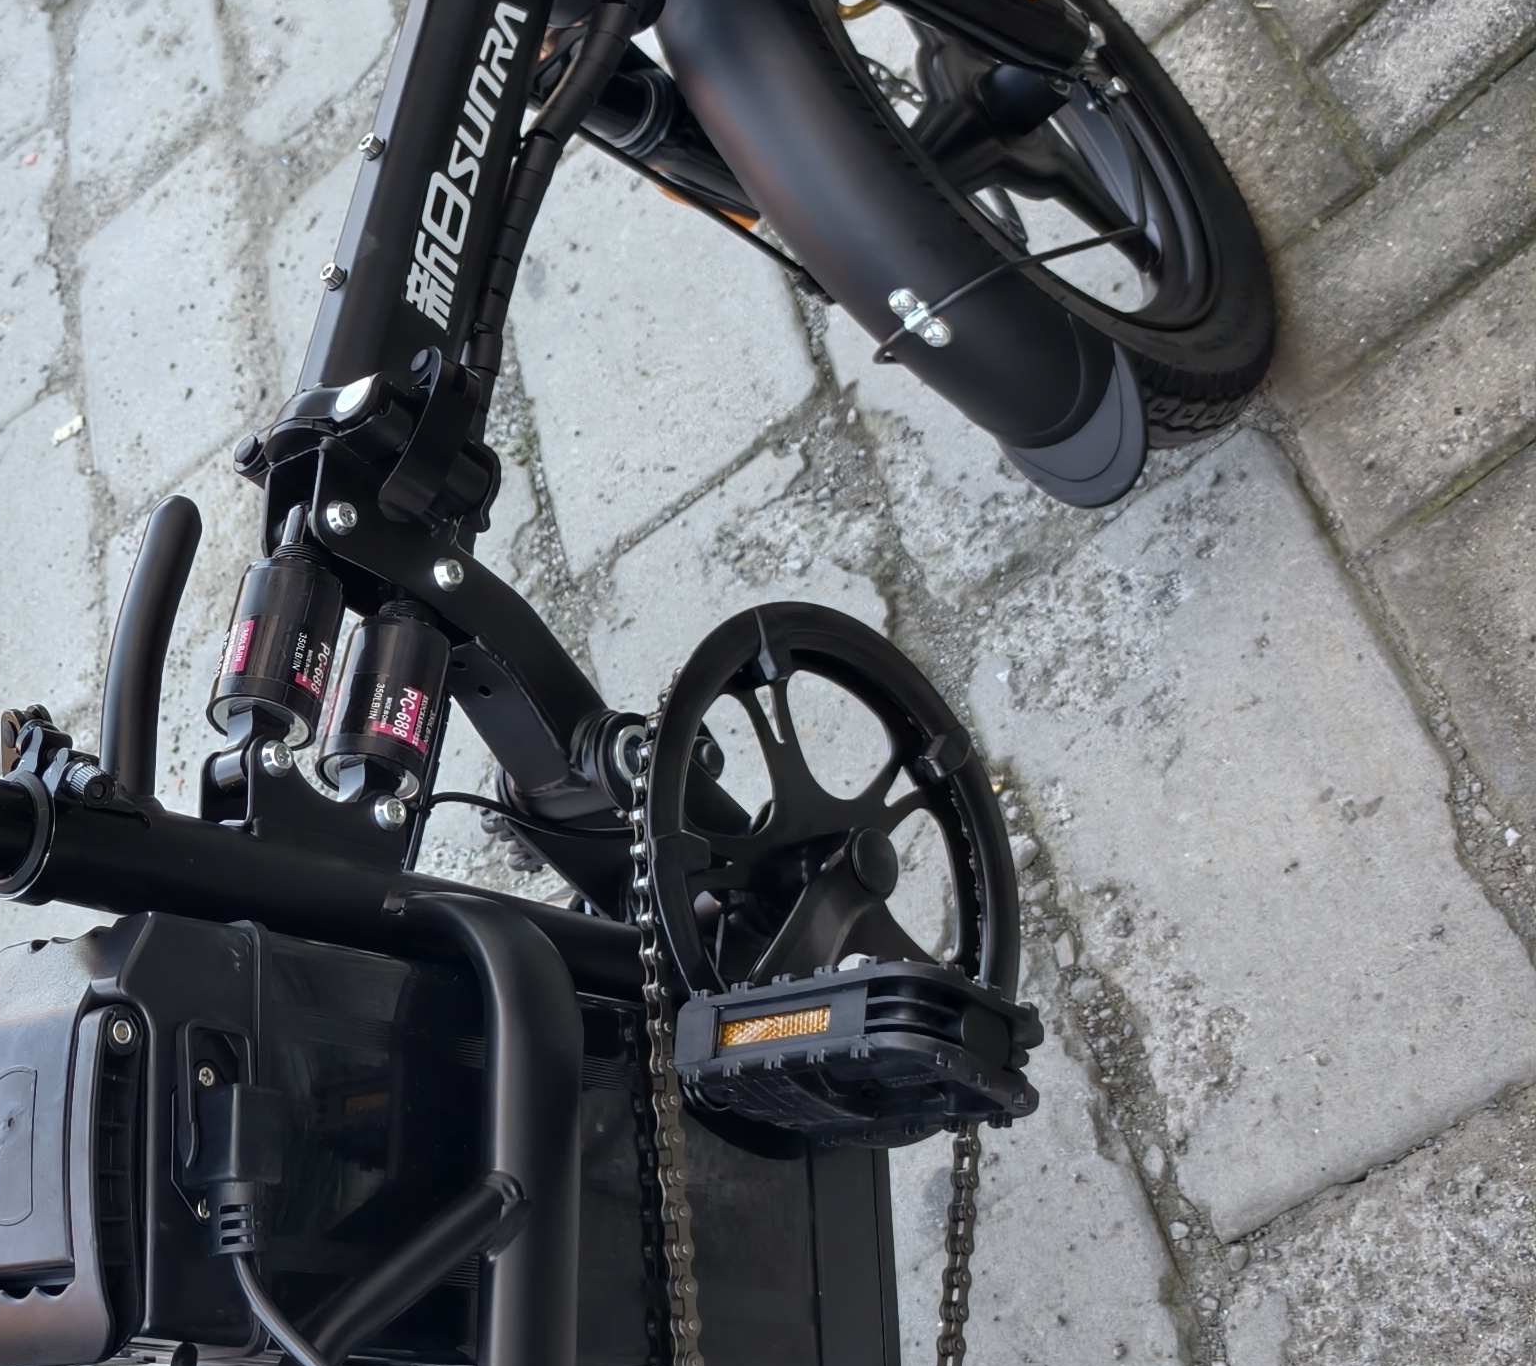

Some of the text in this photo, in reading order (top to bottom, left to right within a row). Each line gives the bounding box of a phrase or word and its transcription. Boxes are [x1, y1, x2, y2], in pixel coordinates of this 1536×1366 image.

[447, 0, 530, 198] SUNRA
[292, 632, 308, 671] 350LB/IN
[311, 641, 331, 695] PC-688
[367, 682, 386, 720] 350LB/IN
[392, 687, 418, 738] PC-688
